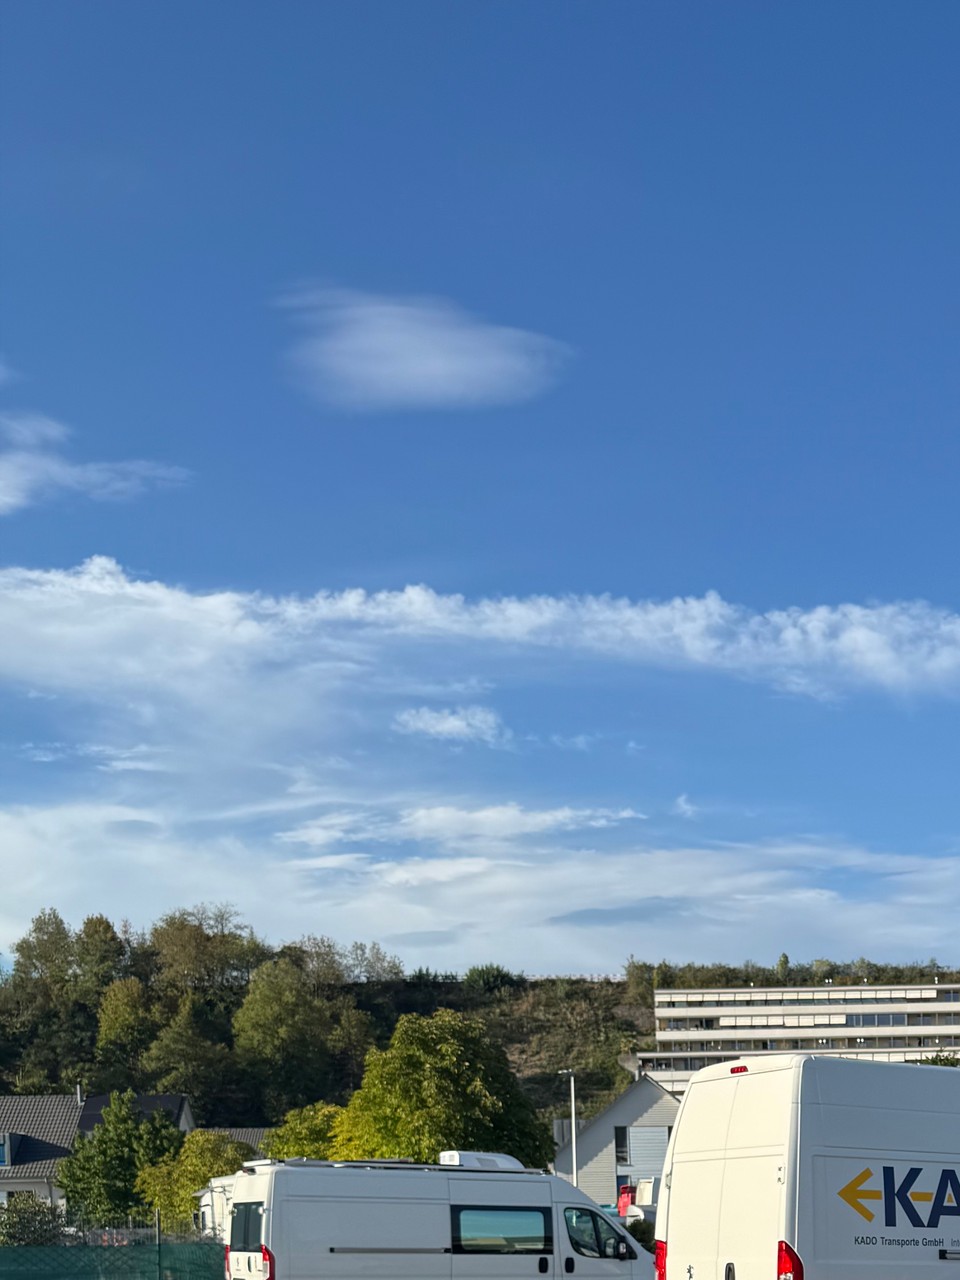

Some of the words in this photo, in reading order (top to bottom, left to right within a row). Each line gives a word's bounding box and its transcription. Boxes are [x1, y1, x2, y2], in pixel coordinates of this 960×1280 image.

[854, 1236, 878, 1246] KADO
[880, 1236, 920, 1248] Transporte
[922, 1237, 944, 1247] GmbH
